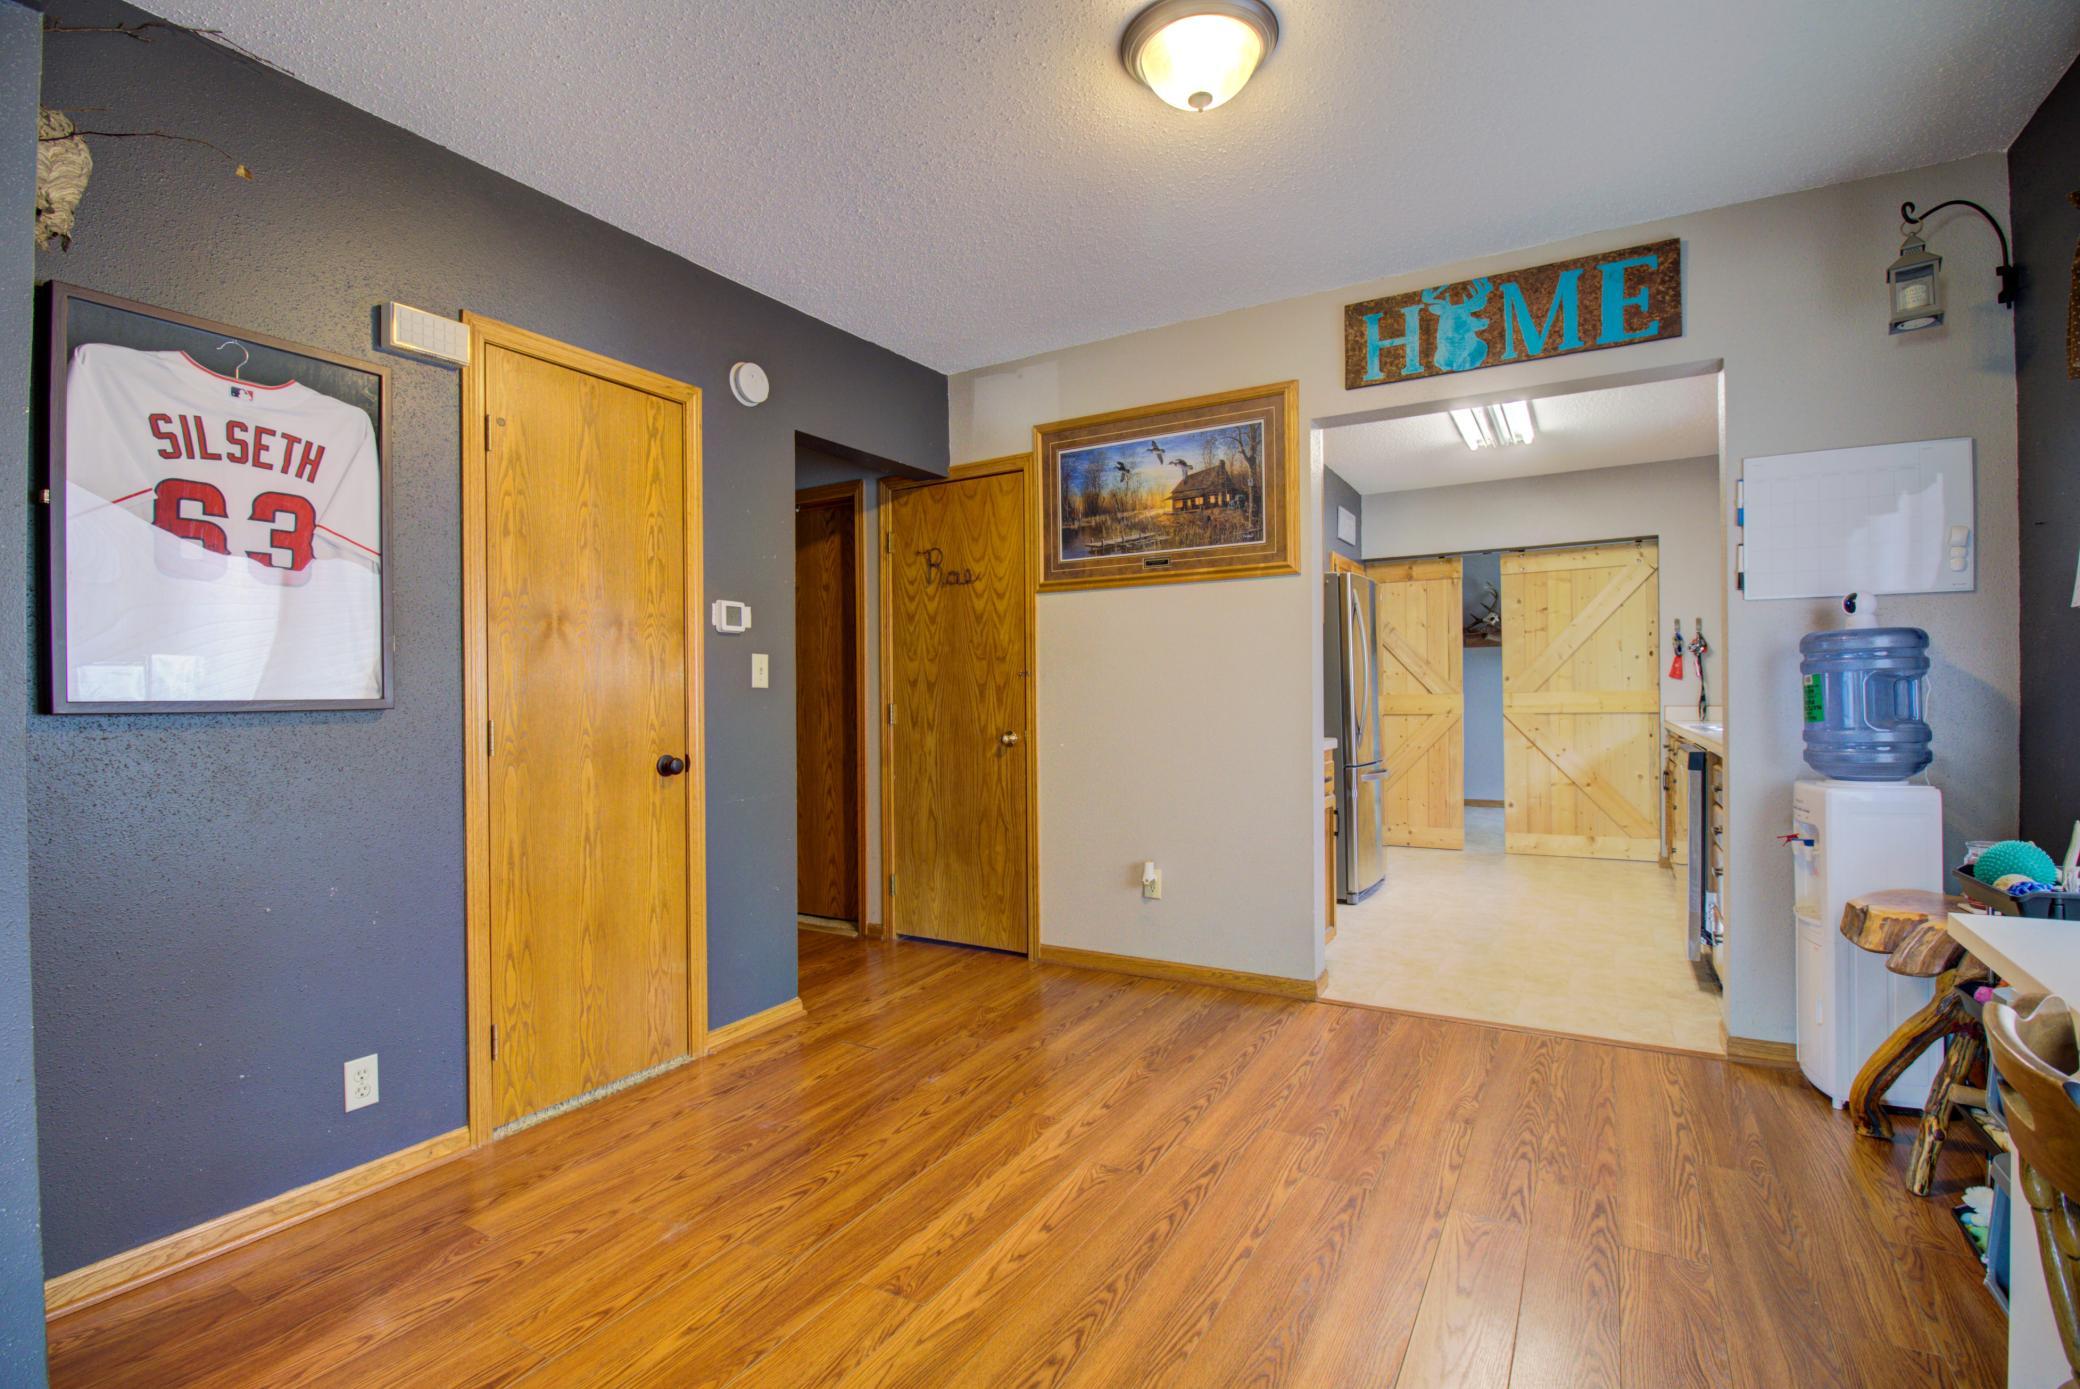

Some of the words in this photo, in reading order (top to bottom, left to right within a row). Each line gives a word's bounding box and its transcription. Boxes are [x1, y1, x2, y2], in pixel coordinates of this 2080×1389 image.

[1362, 255, 1660, 382] HME
[148, 412, 326, 484] SILSETH
[151, 477, 317, 587] 63
